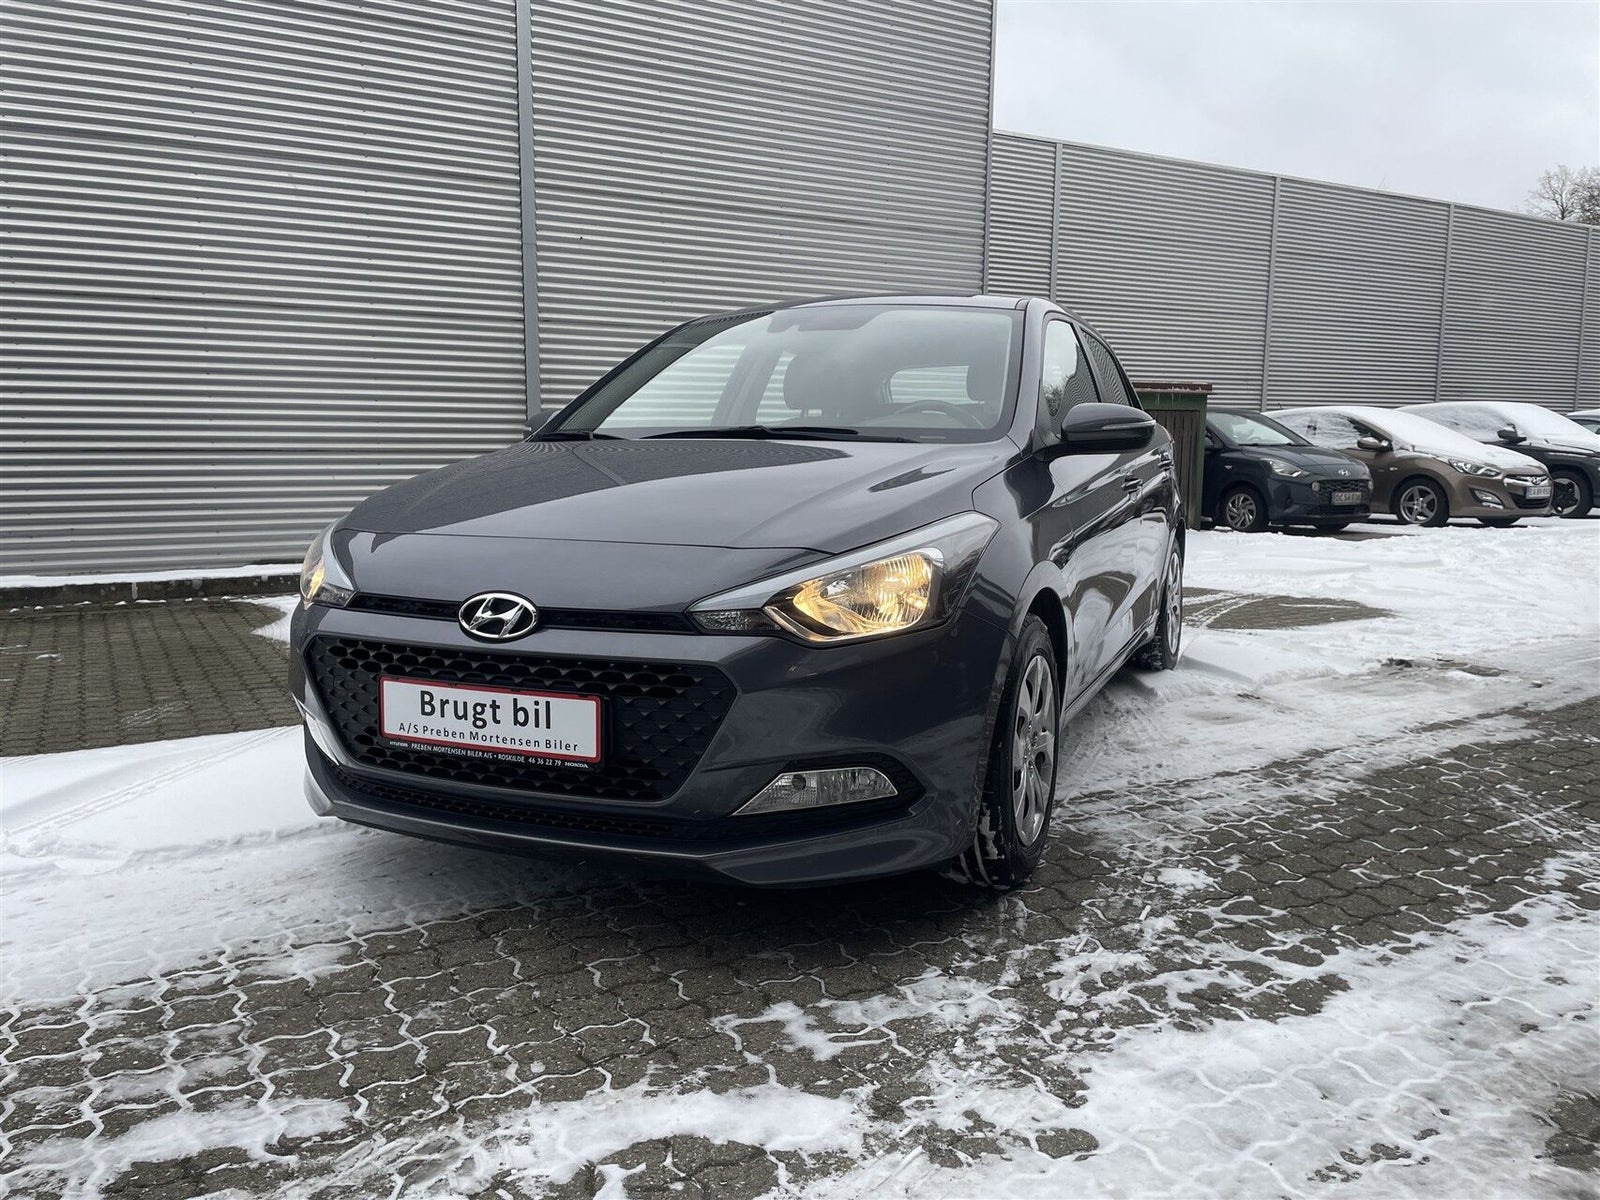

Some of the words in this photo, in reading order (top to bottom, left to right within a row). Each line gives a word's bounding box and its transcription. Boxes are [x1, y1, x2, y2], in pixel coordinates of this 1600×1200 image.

[420, 690, 501, 729] Brugt
[513, 698, 551, 729] bil
[399, 722, 419, 734] A/S
[423, 725, 465, 739] Preben
[469, 731, 540, 747] Mortensen
[545, 739, 578, 752] Biler
[411, 743, 432, 752] PREBEN
[433, 745, 466, 756] MORTENSEN
[467, 750, 483, 758] BILER
[498, 753, 525, 763] ROSKILDE
[554, 759, 562, 767] 79
[564, 761, 589, 769] HONDA
